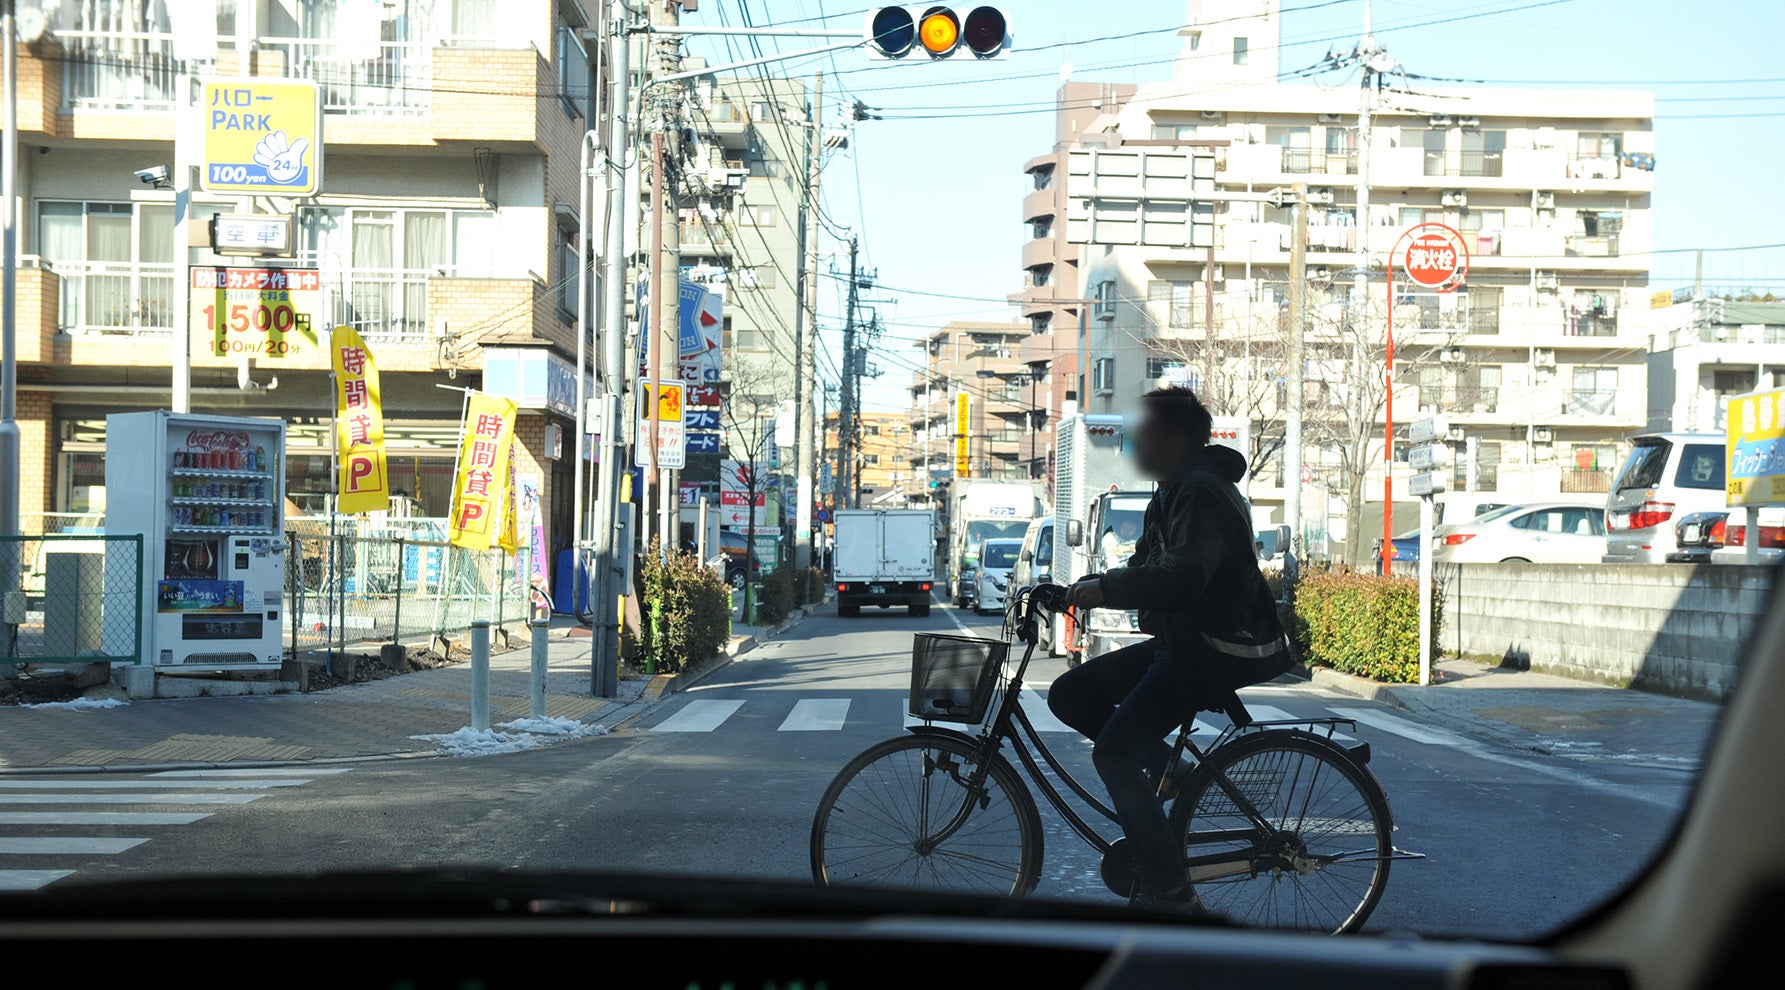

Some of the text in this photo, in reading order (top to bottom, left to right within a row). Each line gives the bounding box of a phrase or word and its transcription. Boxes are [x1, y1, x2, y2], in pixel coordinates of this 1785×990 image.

[211, 88, 273, 107] ハロー
[211, 110, 272, 131] PARK
[227, 224, 276, 244] 空車
[1409, 248, 1455, 271] 消火栓
[195, 270, 318, 290] 防犯カメラ作動中
[341, 346, 373, 448] 時間貸
[464, 414, 503, 497] 時間貸
[350, 457, 373, 491] P
[459, 503, 483, 530] P
